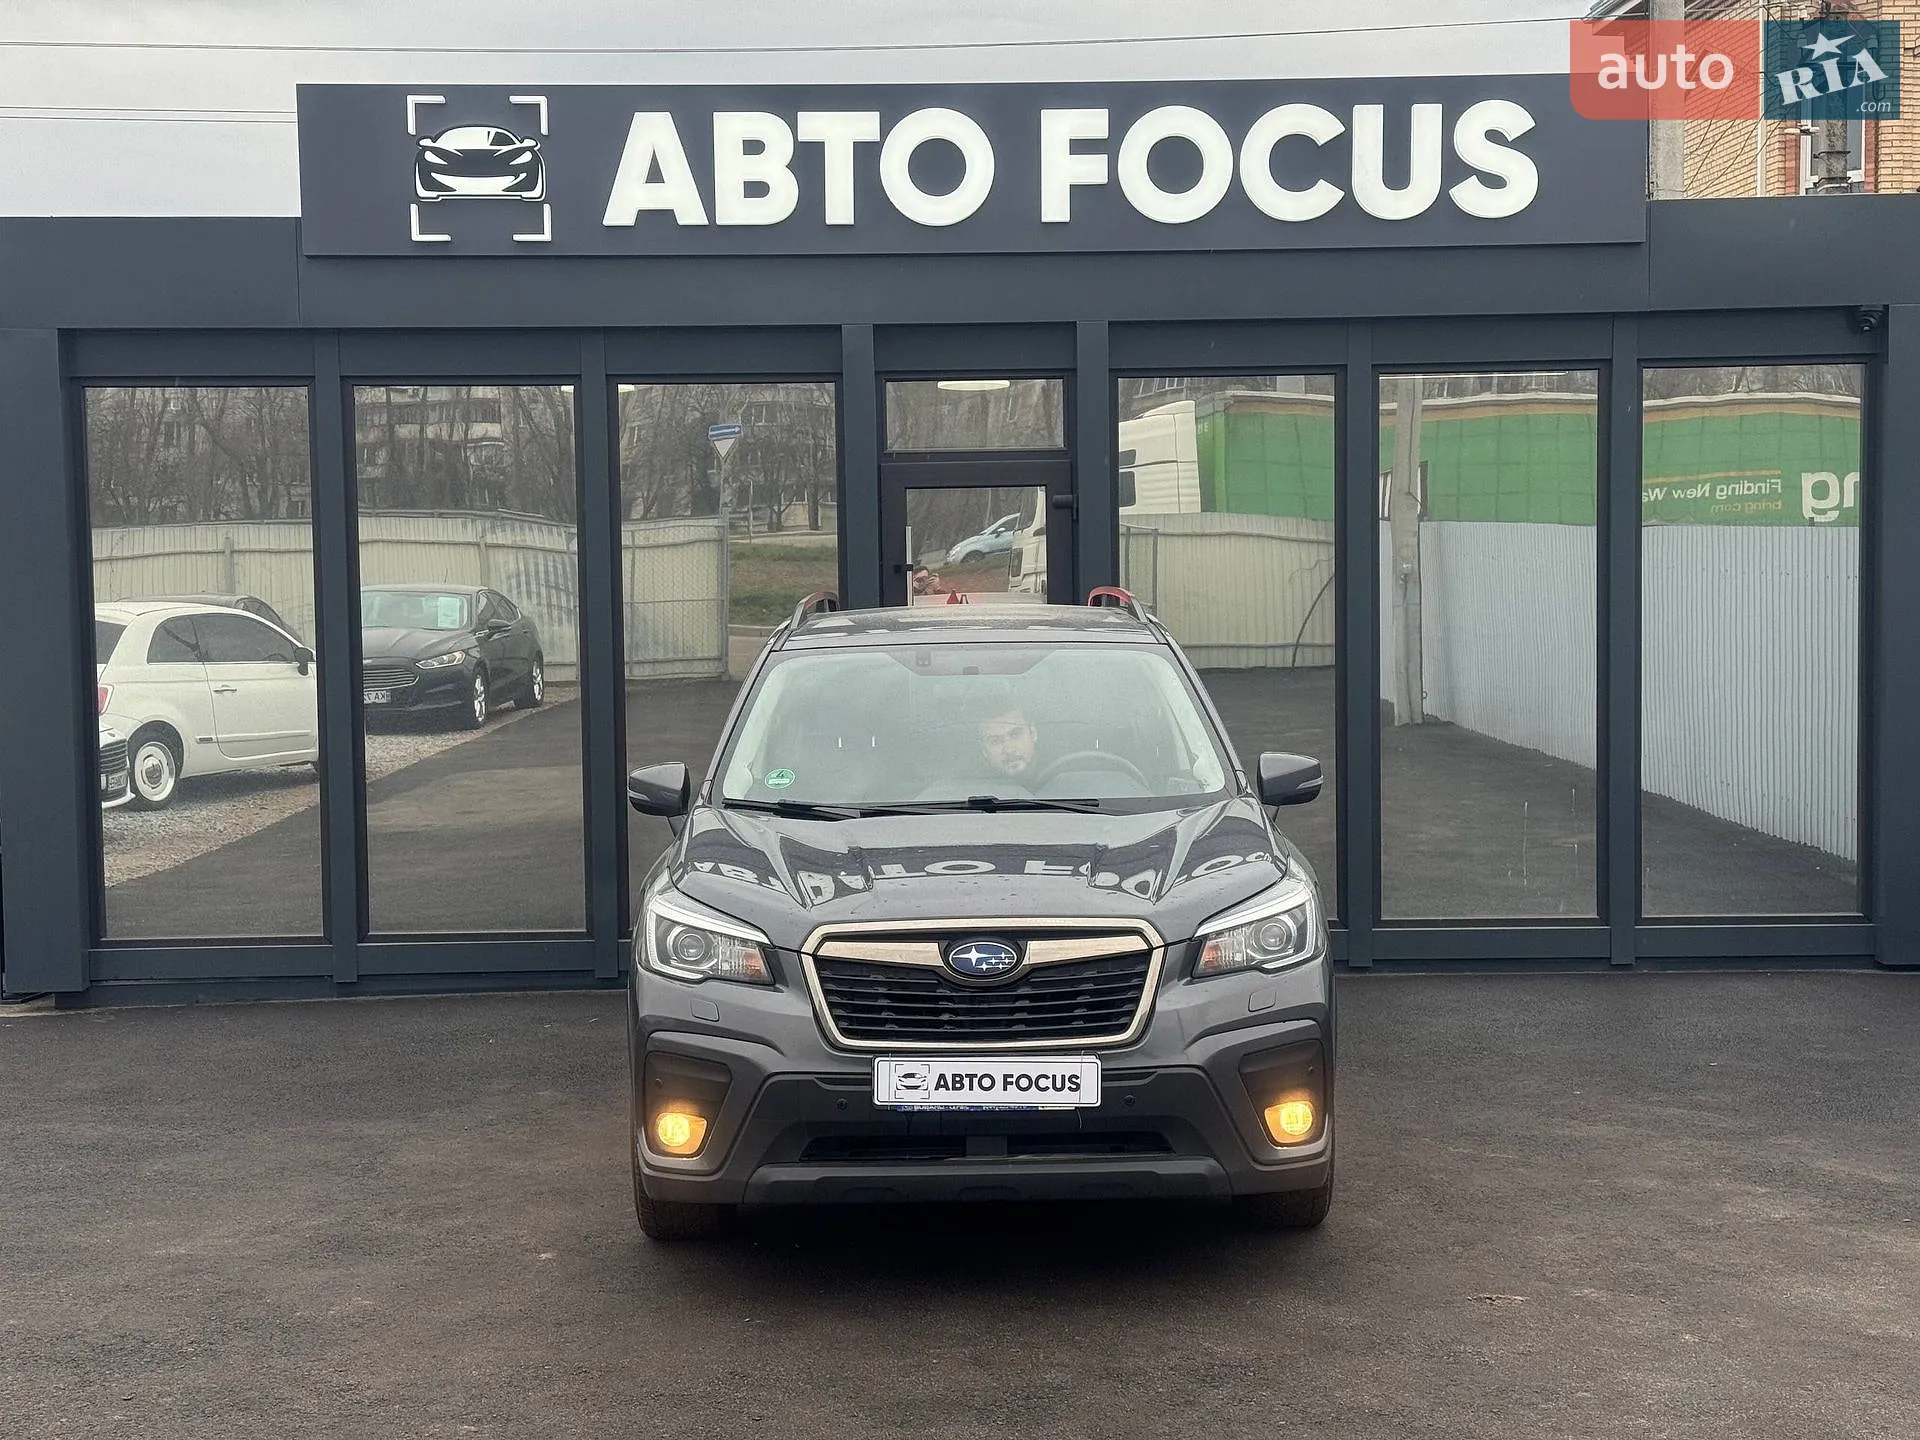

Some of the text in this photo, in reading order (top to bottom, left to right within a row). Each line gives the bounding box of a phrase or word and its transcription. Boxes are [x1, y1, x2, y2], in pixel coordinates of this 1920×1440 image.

[602, 99, 1539, 227] АВТО FOCUS
[933, 1073, 1080, 1093] АВТО FOCUS
